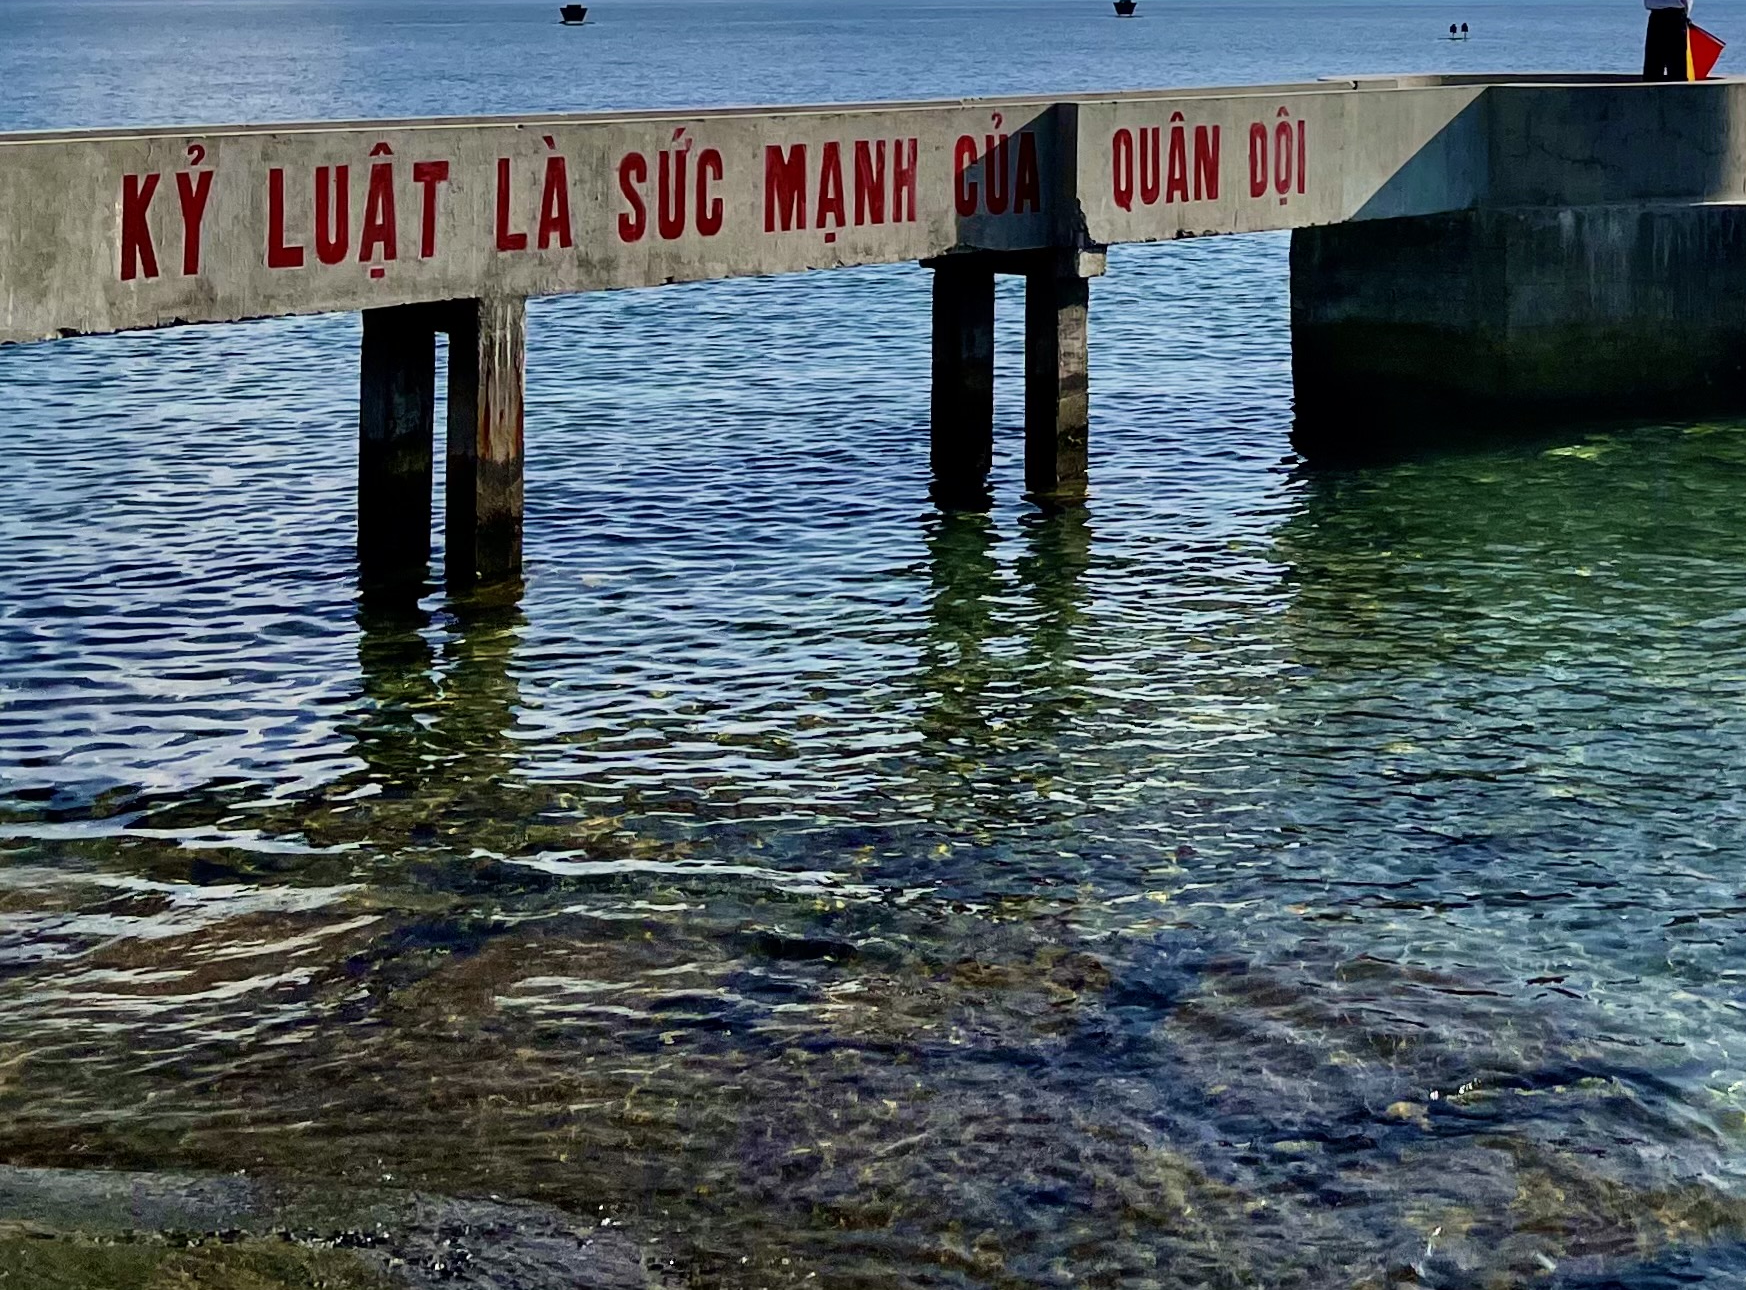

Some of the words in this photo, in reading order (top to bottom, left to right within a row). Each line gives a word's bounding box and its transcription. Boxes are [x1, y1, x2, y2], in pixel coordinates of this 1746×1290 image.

[119, 143, 214, 282] KỶ
[266, 141, 450, 280] LUẬT
[495, 135, 574, 253] LÀ
[616, 126, 726, 244] SỨC
[762, 136, 919, 245] MẠNH
[952, 112, 1042, 218] CỦA
[1111, 111, 1222, 213] QUÂN
